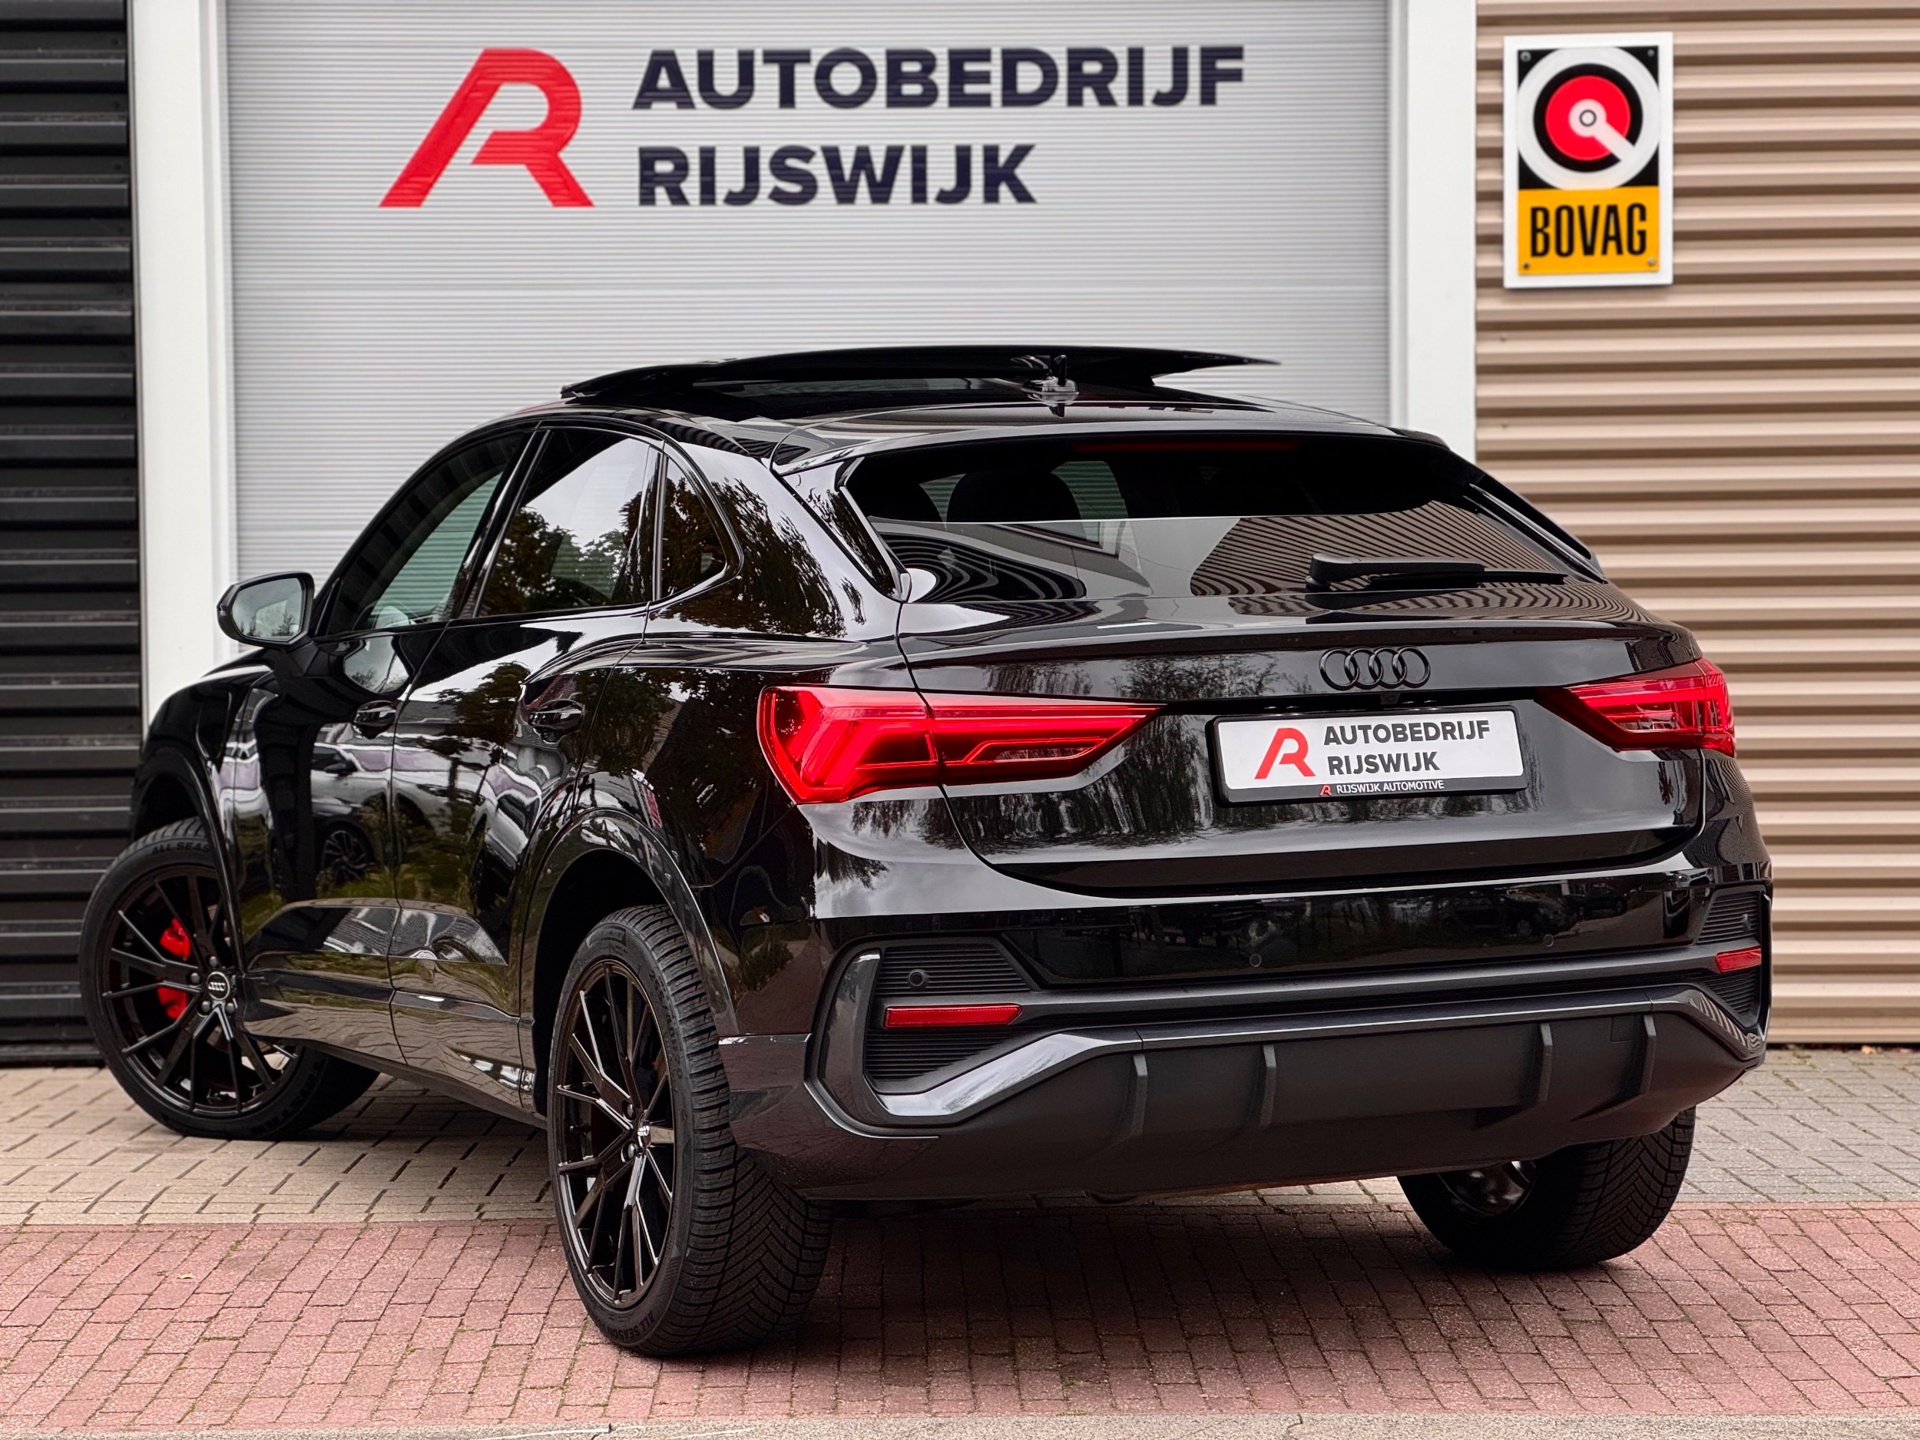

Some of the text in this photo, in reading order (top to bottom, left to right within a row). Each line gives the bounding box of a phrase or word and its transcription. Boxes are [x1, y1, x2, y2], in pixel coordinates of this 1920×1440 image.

[632, 46, 1244, 110] AUTOBEDRIJF
[638, 144, 1037, 206] RIJSWIJK
[1530, 202, 1647, 257] BOVAG
[1323, 719, 1490, 746] AUTOBEDRIJF
[1327, 751, 1440, 776] RIJSWIJK
[1336, 779, 1445, 794] RIJSWIJK AUTOMOTIVE
[176, 841, 210, 853] SEAS
